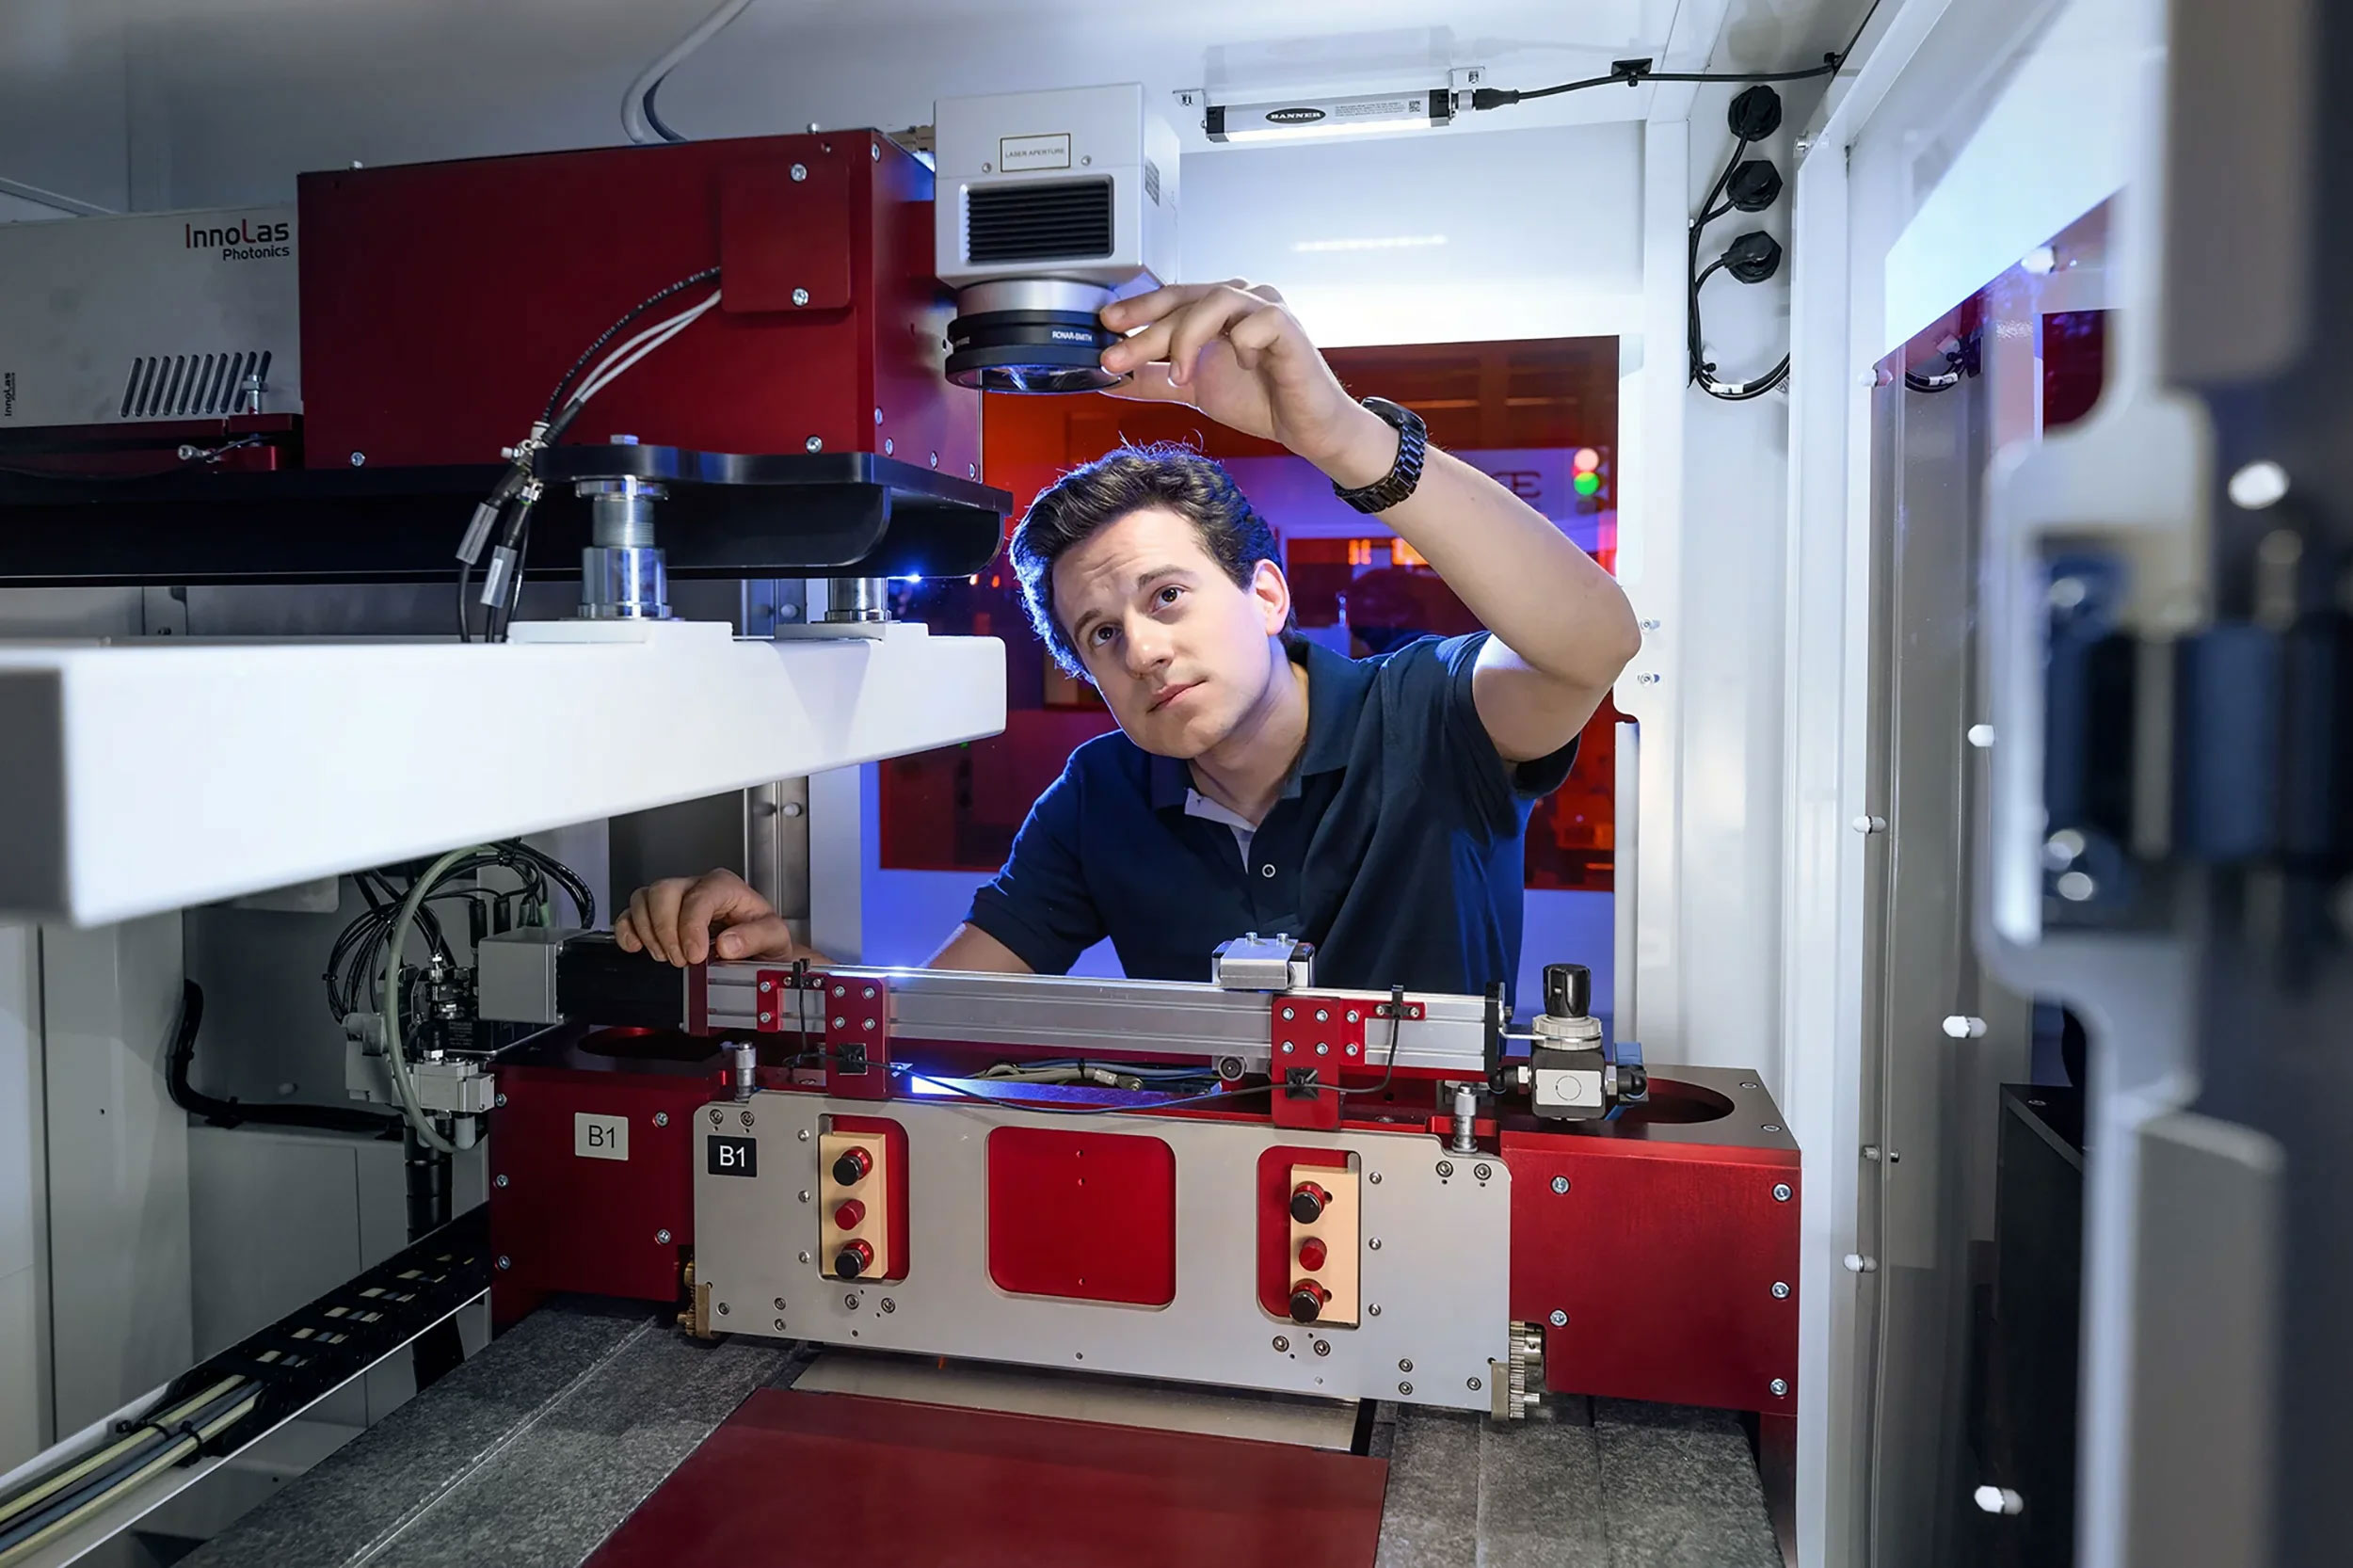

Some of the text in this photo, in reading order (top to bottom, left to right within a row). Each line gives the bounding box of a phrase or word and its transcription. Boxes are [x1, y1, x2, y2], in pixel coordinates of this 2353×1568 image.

[1271, 111, 1321, 120] BANNER
[1029, 148, 1064, 157] APERTURE
[185, 218, 289, 248] InnoLas
[223, 245, 290, 261] Photonics
[588, 1125, 615, 1148] B1
[719, 1145, 745, 1167] B1
